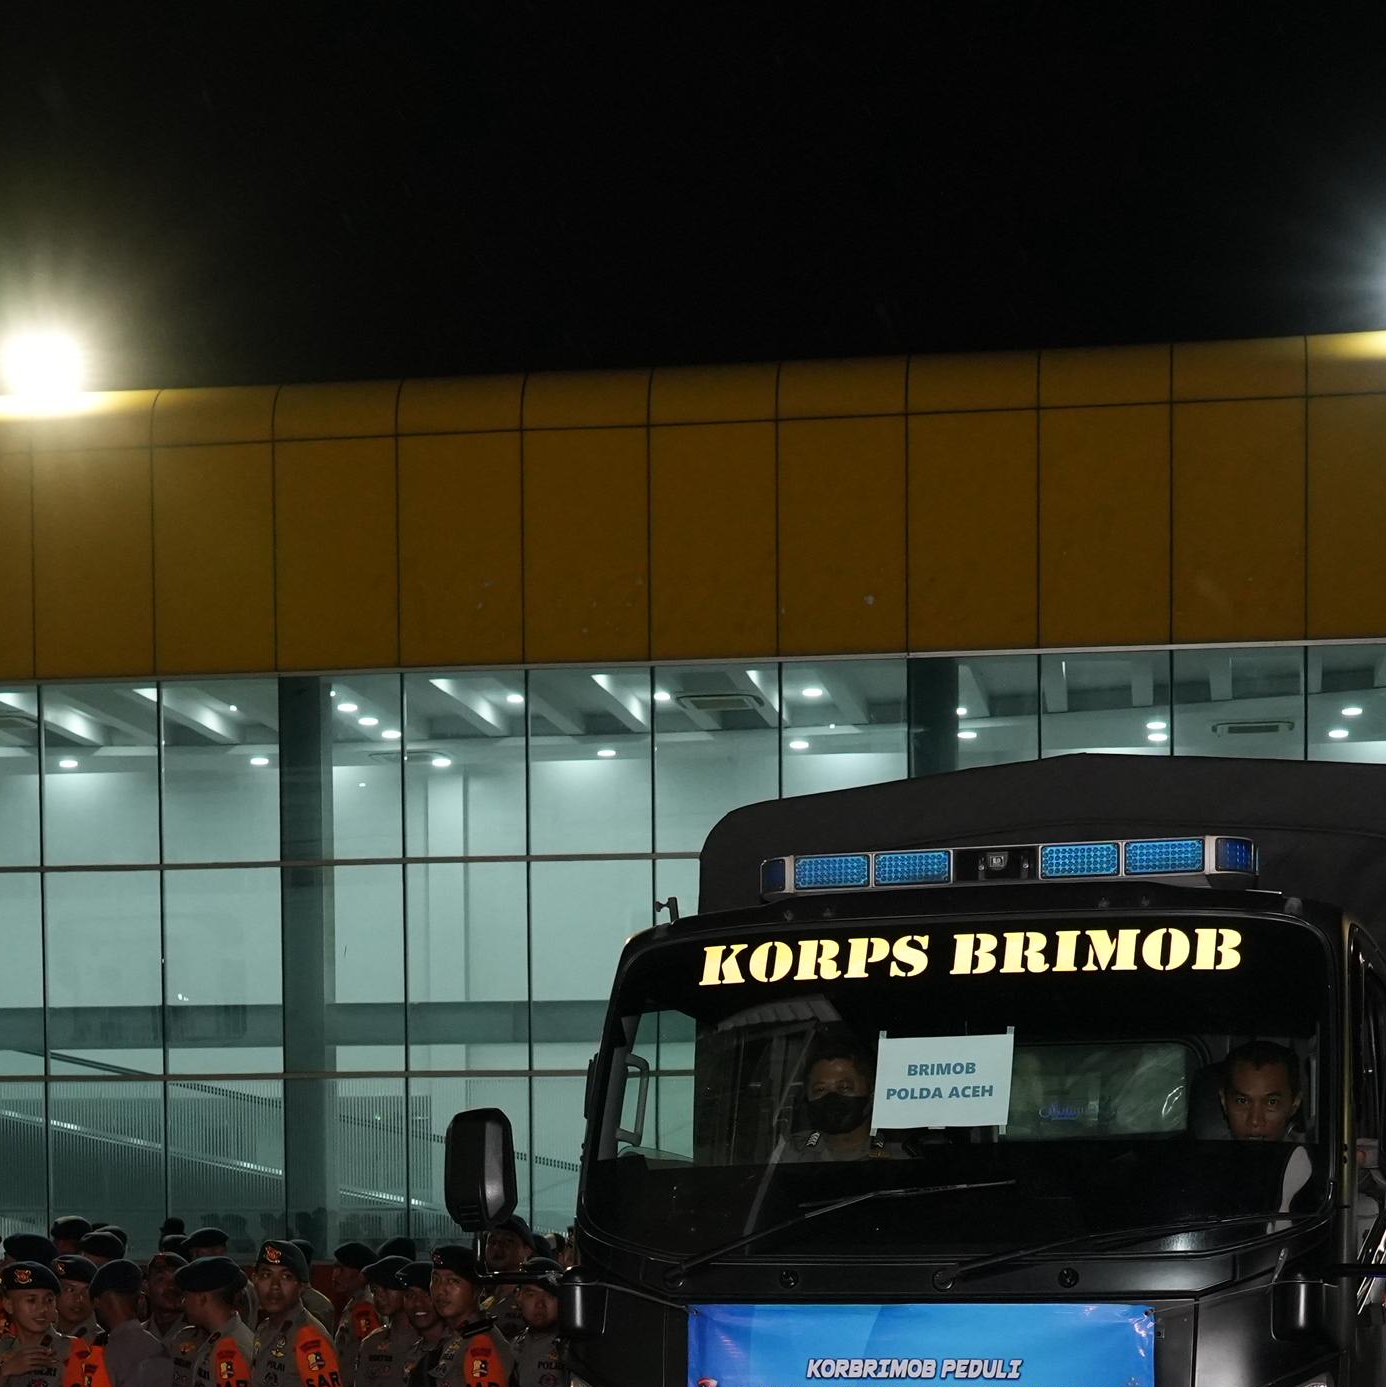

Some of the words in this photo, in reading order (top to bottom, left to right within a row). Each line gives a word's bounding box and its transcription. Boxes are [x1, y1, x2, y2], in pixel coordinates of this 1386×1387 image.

[698, 933, 932, 986] KORPS
[949, 926, 1244, 976] BRIMOB
[906, 1061, 977, 1077] BRIMOB
[885, 1086, 944, 1101] POLDA
[948, 1084, 994, 1099] ACEH
[806, 1358, 937, 1379] KORBRIMOB
[940, 1358, 1023, 1379] PEDULI
